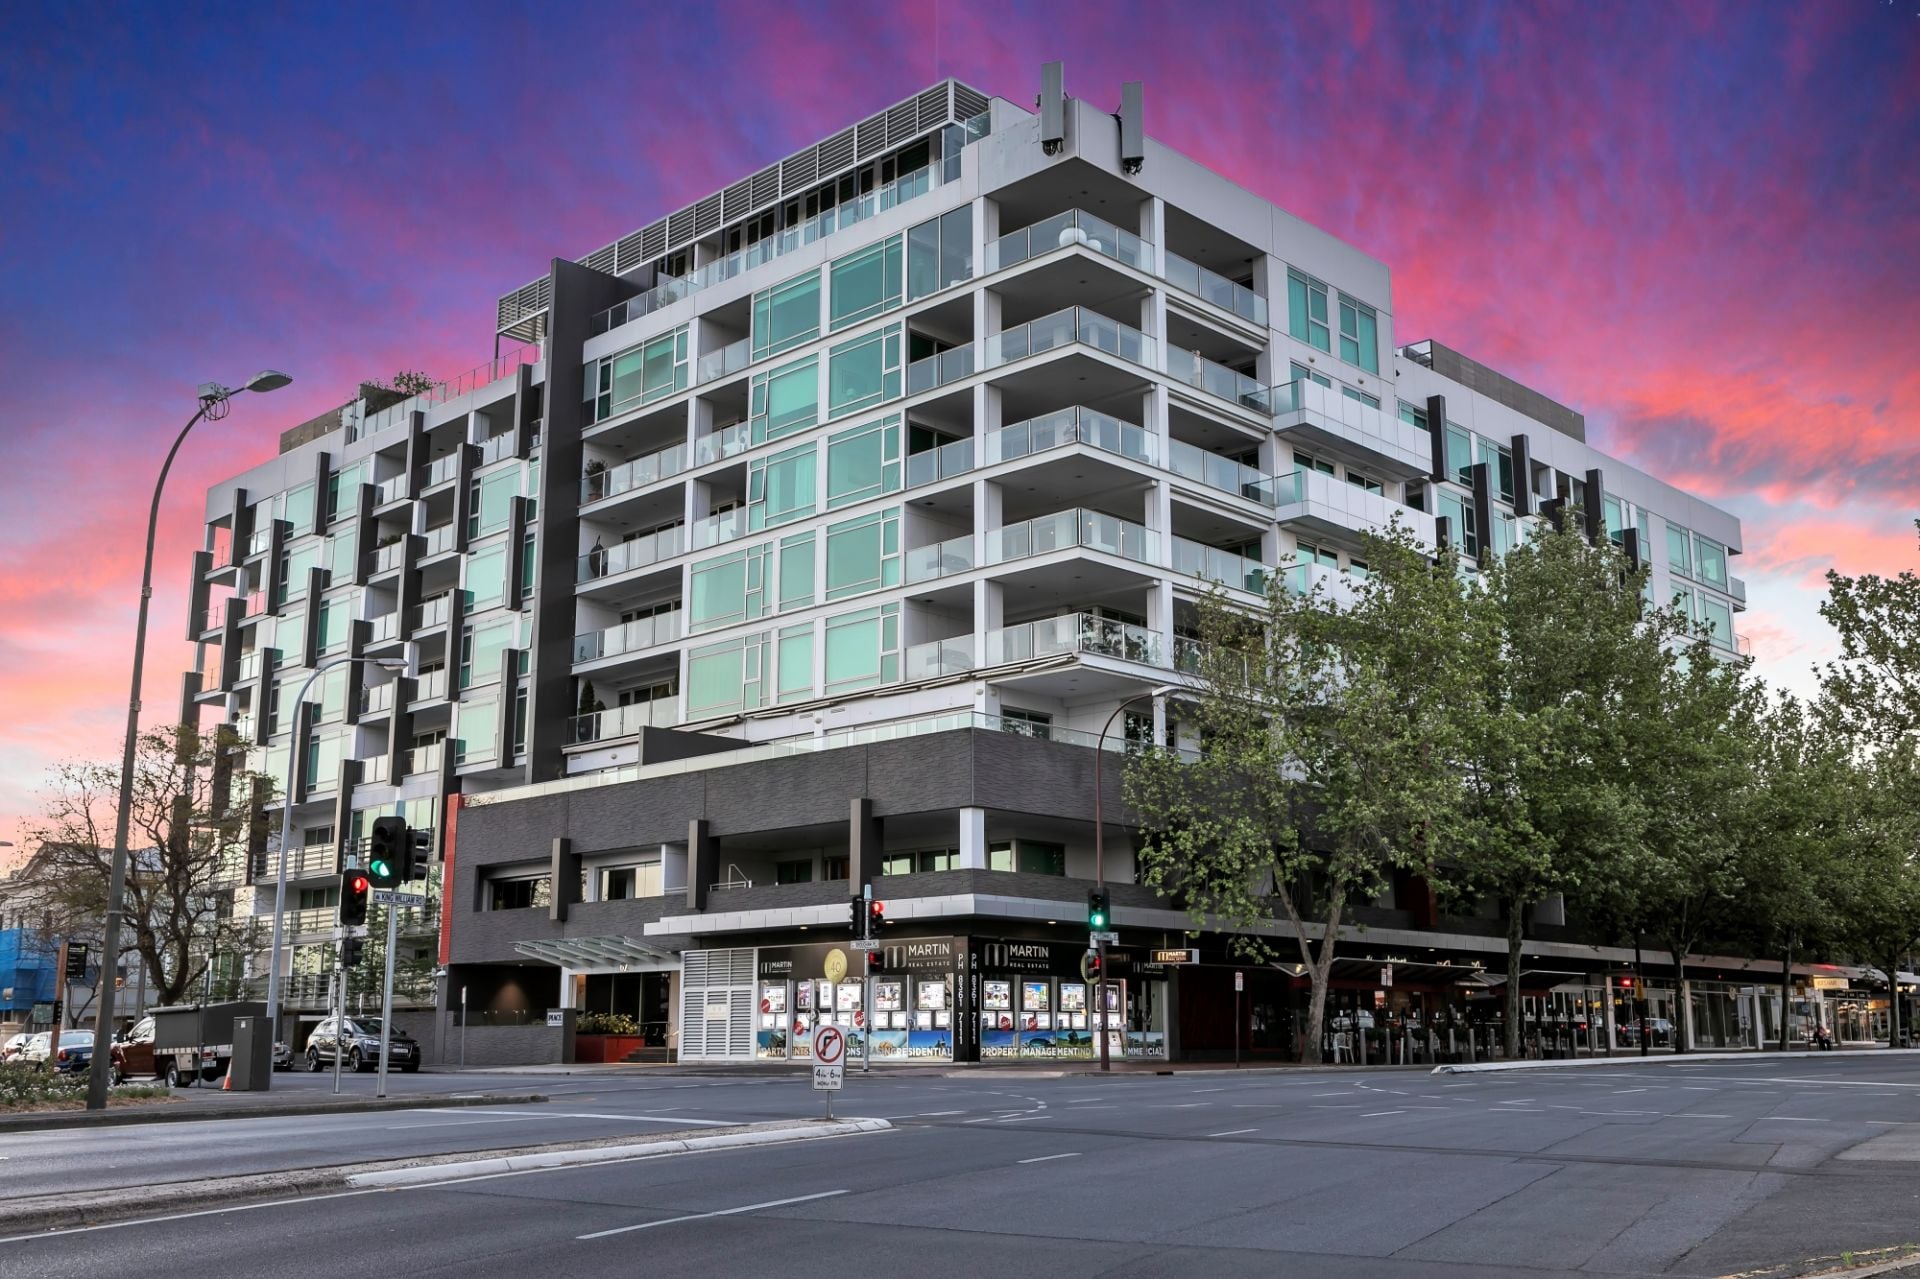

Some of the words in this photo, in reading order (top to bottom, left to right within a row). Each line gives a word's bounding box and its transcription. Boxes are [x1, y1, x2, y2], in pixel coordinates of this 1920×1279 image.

[382, 892, 394, 902] KING
[395, 893, 416, 904] WILLIAM
[908, 943, 950, 956] MARTIN
[1009, 944, 1049, 958] MARTIN
[771, 961, 793, 969] MARTIN
[957, 953, 964, 970] PH
[971, 953, 977, 970] PH
[1143, 962, 1164, 970] MARTIN
[896, 1047, 953, 1057] RESIDENTIAL
[1023, 1047, 1078, 1057] MANAGEMENT
